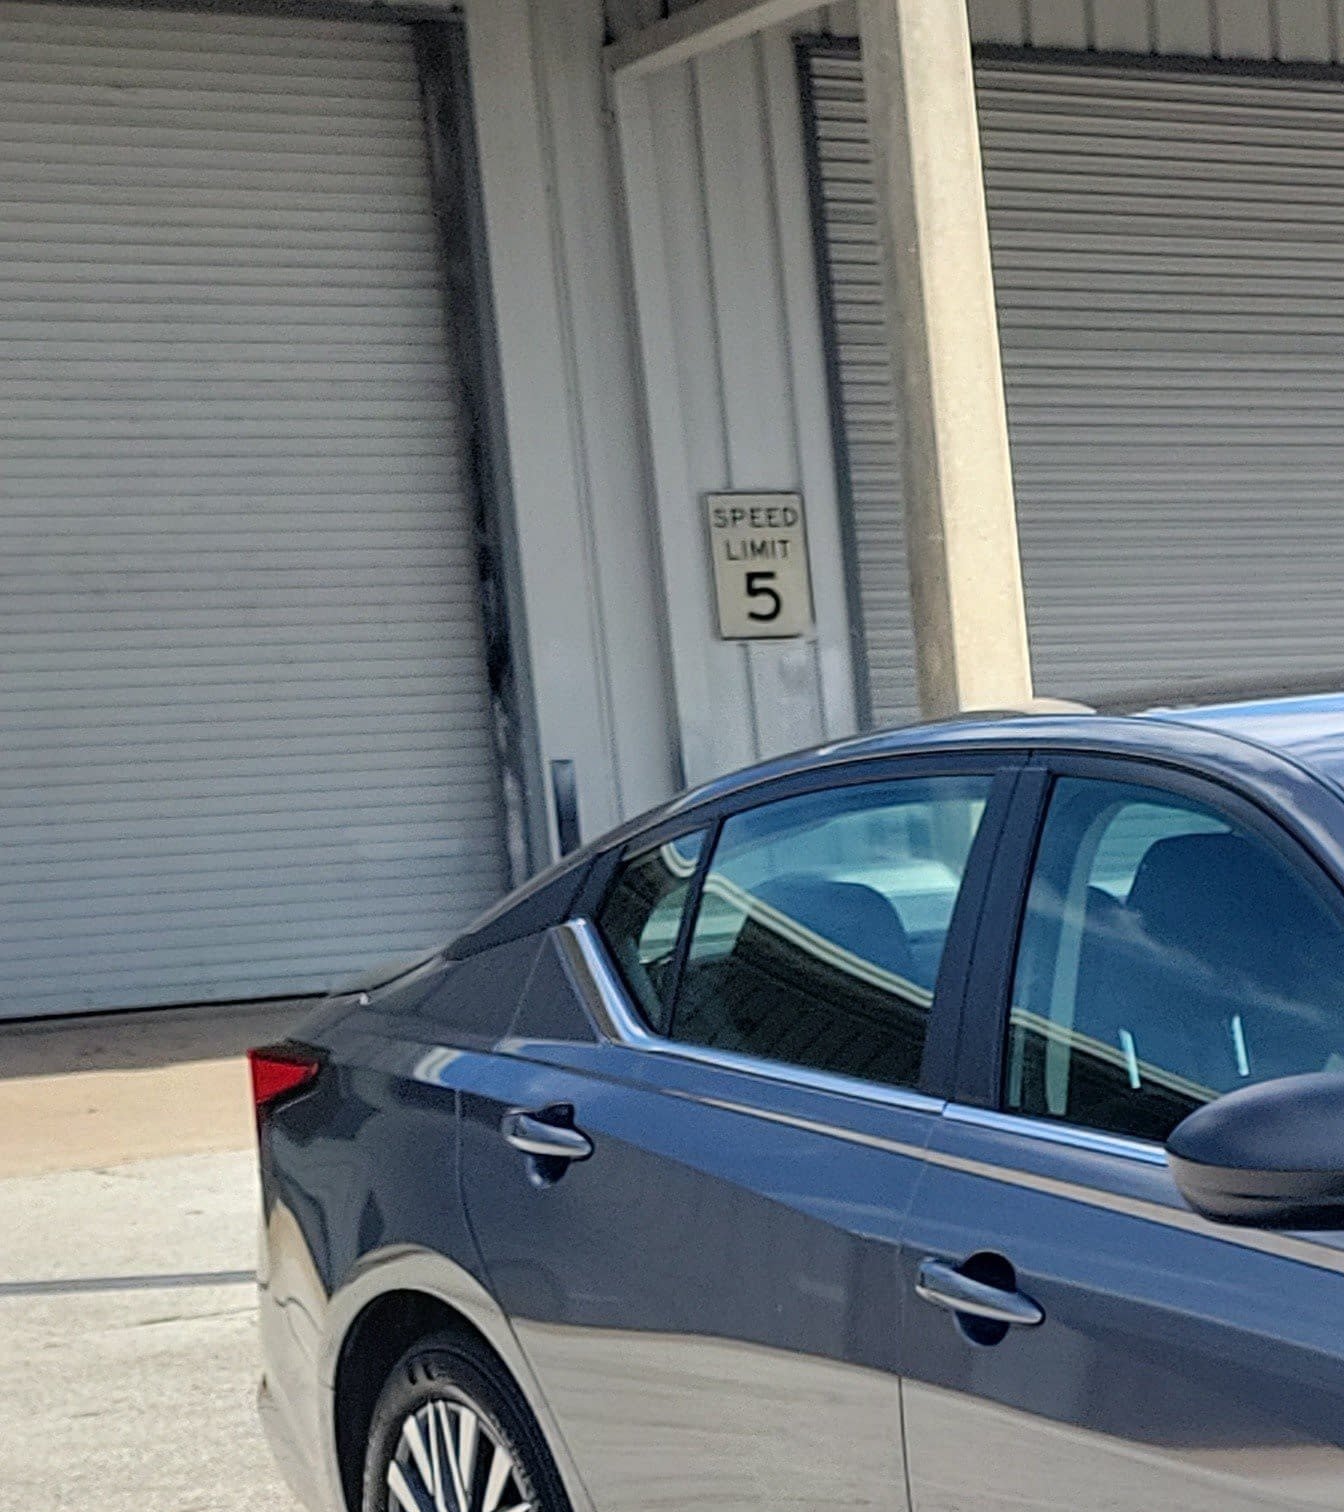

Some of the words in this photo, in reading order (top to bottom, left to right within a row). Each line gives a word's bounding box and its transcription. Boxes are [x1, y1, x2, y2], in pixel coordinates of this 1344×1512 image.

[713, 507, 799, 529] SPEED
[725, 539, 790, 562] LIMIT
[745, 571, 782, 622] 5
